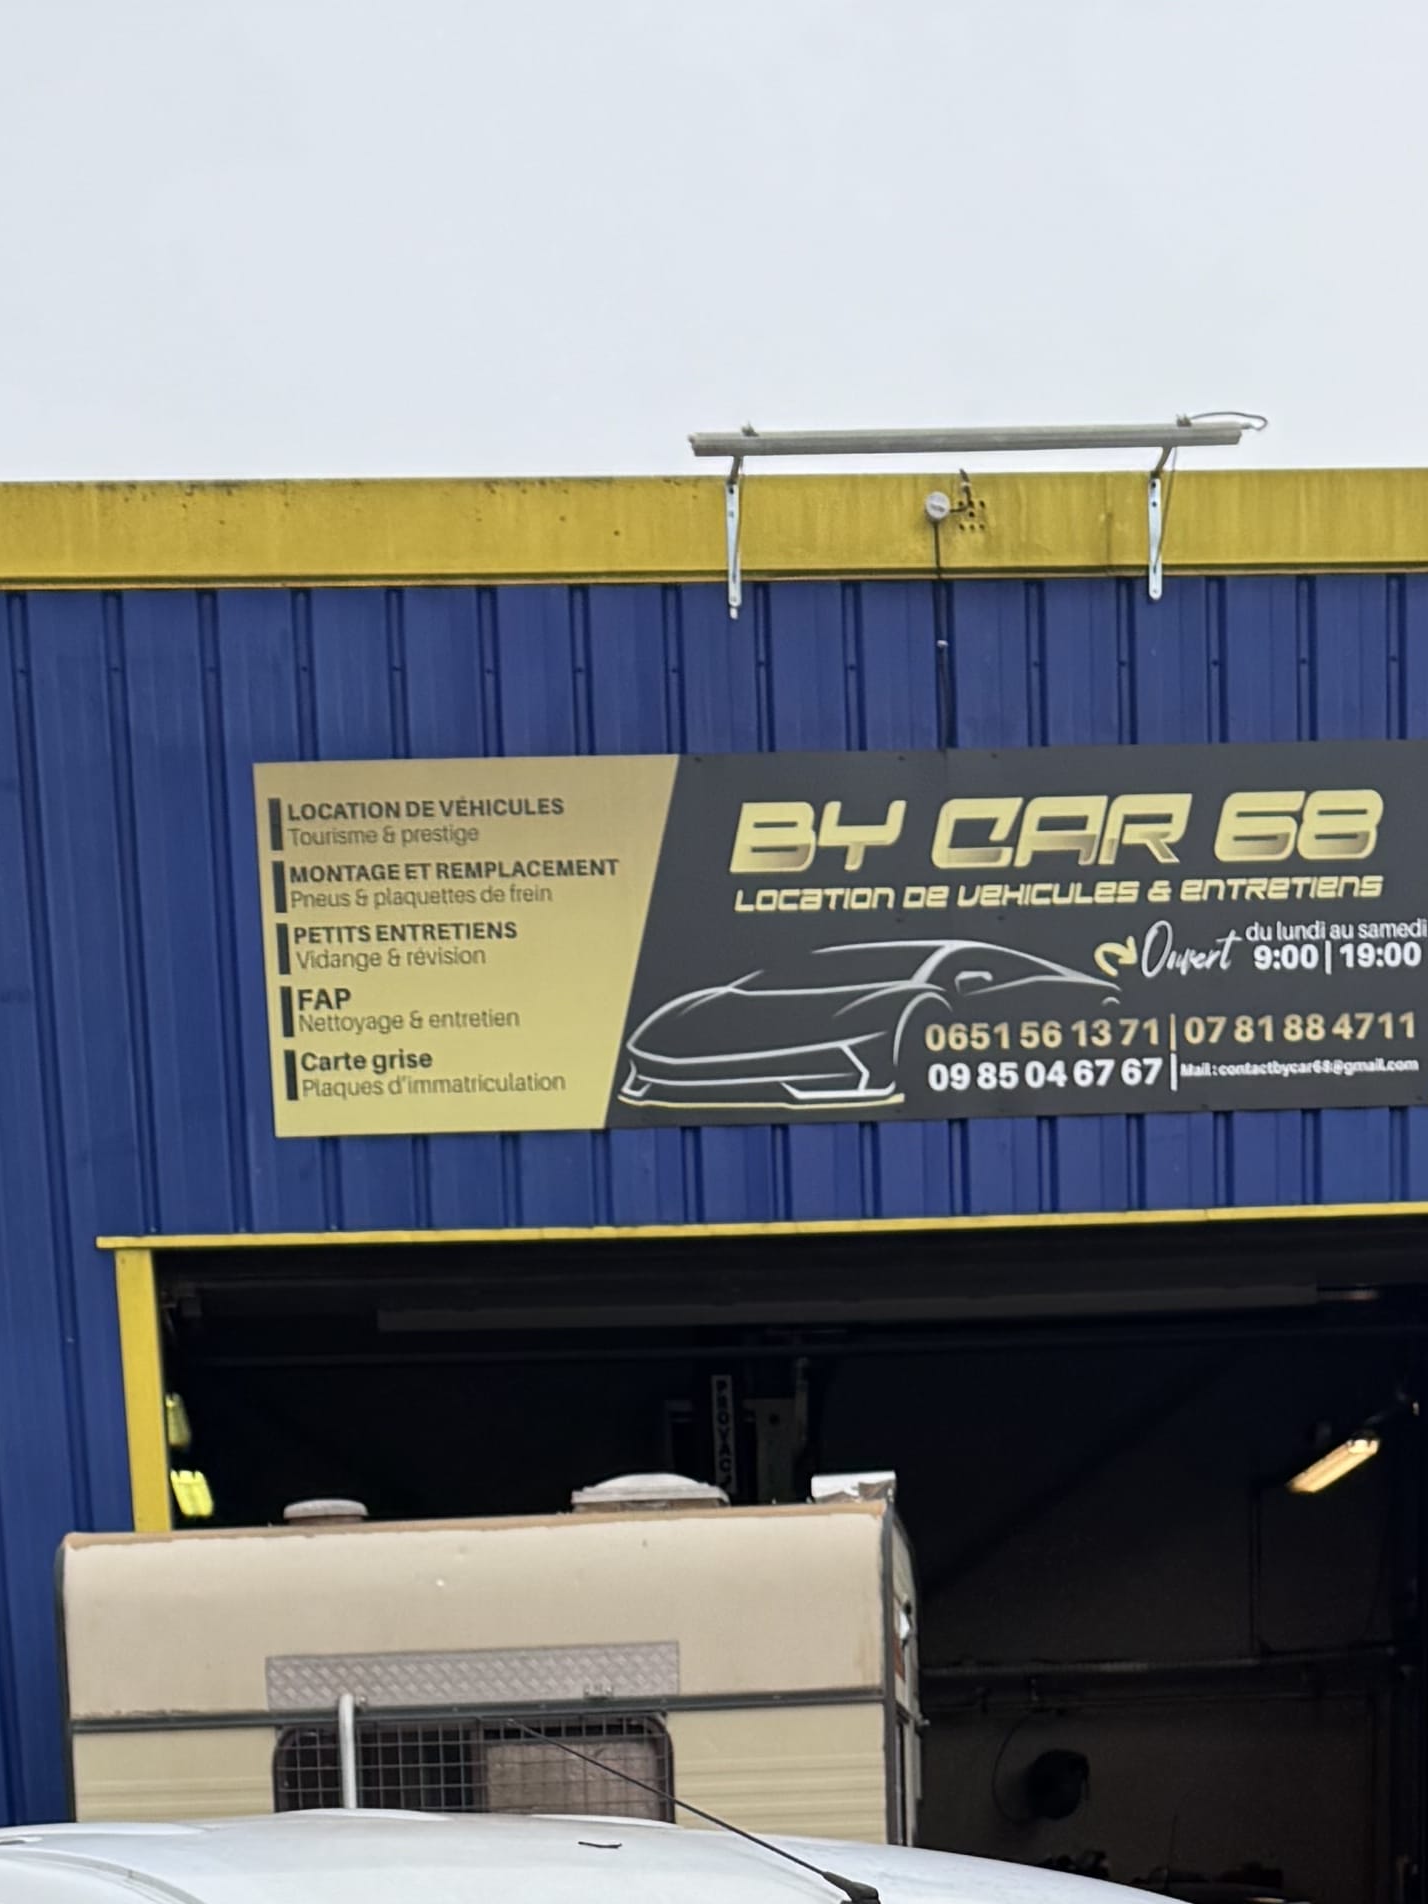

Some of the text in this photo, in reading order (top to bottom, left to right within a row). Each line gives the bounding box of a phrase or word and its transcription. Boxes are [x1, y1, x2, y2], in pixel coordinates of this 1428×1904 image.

[288, 796, 564, 821] LOCATION DE VÉHICULES
[288, 824, 479, 847] Tourisme & prestige
[729, 789, 1384, 873] BY CAR 68
[289, 858, 619, 883] MONTAGE ET REMPLACEMENT
[291, 883, 553, 911] Pneus & plaquettes de frein
[1146, 879, 1172, 902] &
[294, 921, 518, 944] PETITS ENTRETIENS
[1245, 918, 1428, 941] du lundi au samedi
[296, 946, 486, 972] Vidange & révision
[1141, 920, 1242, 978] Ouvert
[1253, 941, 1422, 970] 9:00 19:00
[298, 988, 351, 1010] FAP
[299, 1007, 520, 1035] Nettoyage & entretien
[1020, 1020, 1062, 1049] 56
[1071, 1018, 1112, 1047] 13
[1119, 1017, 1160, 1046] 71
[1184, 1015, 1227, 1044] 07
[1234, 1014, 1273, 1043] 81
[1283, 1013, 1326, 1041] 88
[300, 1048, 433, 1074] Carte grise
[928, 1057, 1163, 1091] 09 85 04 67 67
[302, 1077, 384, 1101] Plaques
